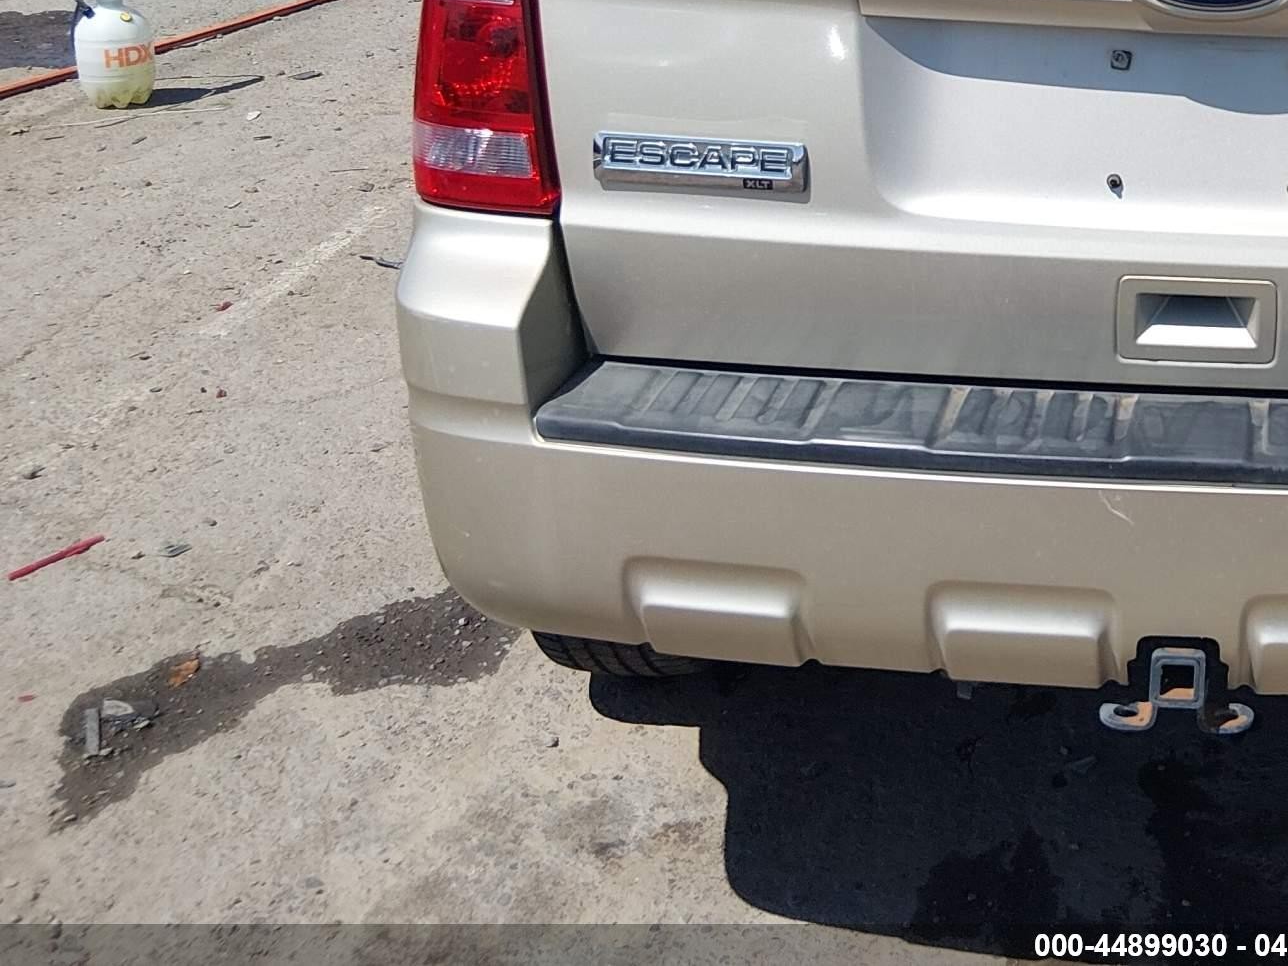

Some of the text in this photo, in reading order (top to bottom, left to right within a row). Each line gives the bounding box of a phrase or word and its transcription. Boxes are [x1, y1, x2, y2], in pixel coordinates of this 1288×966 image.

[104, 43, 153, 69] HDX
[609, 139, 789, 172] ESCAPE
[746, 180, 769, 190] XLT
